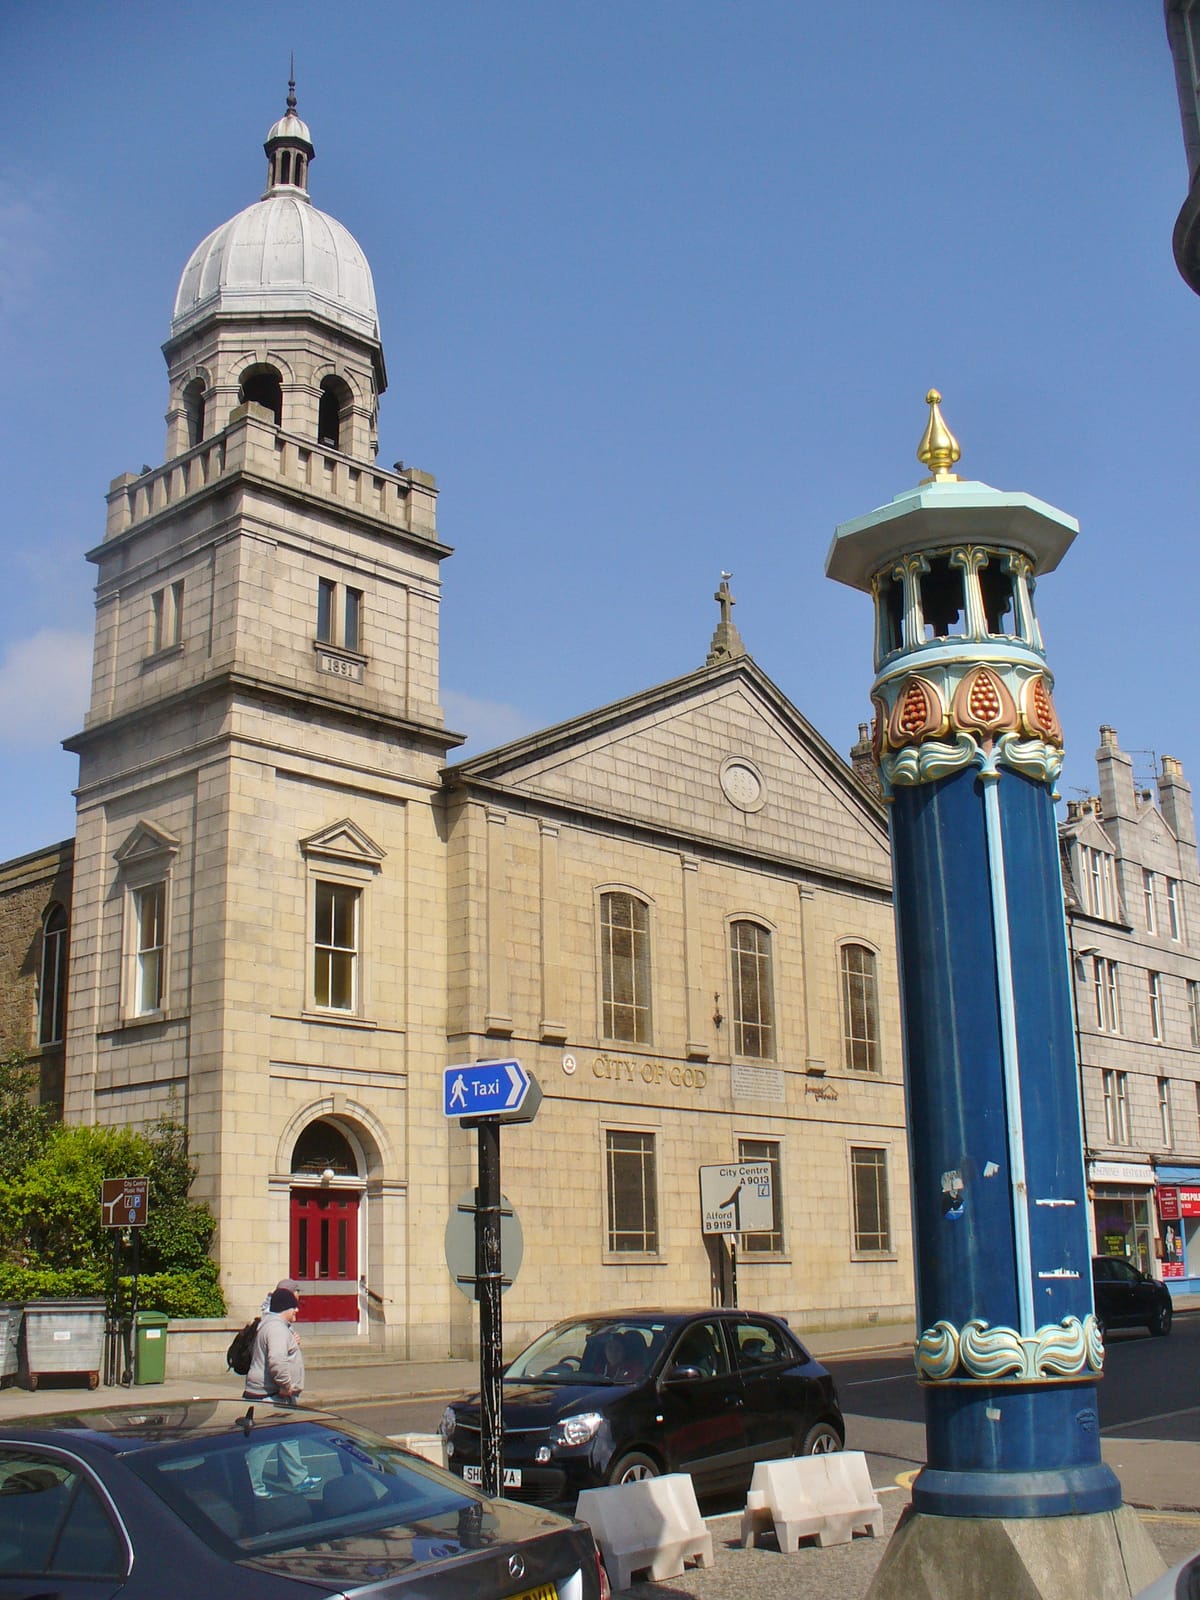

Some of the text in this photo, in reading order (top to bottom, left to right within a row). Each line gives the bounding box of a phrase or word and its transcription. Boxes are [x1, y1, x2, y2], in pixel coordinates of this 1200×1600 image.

[327, 659, 352, 676] 1891
[592, 1056, 636, 1082] CITY
[640, 1061, 665, 1085] OF
[668, 1065, 708, 1089] GOD
[471, 1078, 500, 1097] Taxi
[719, 1166, 769, 1178] City Centre
[706, 1211, 733, 1220] Alford
